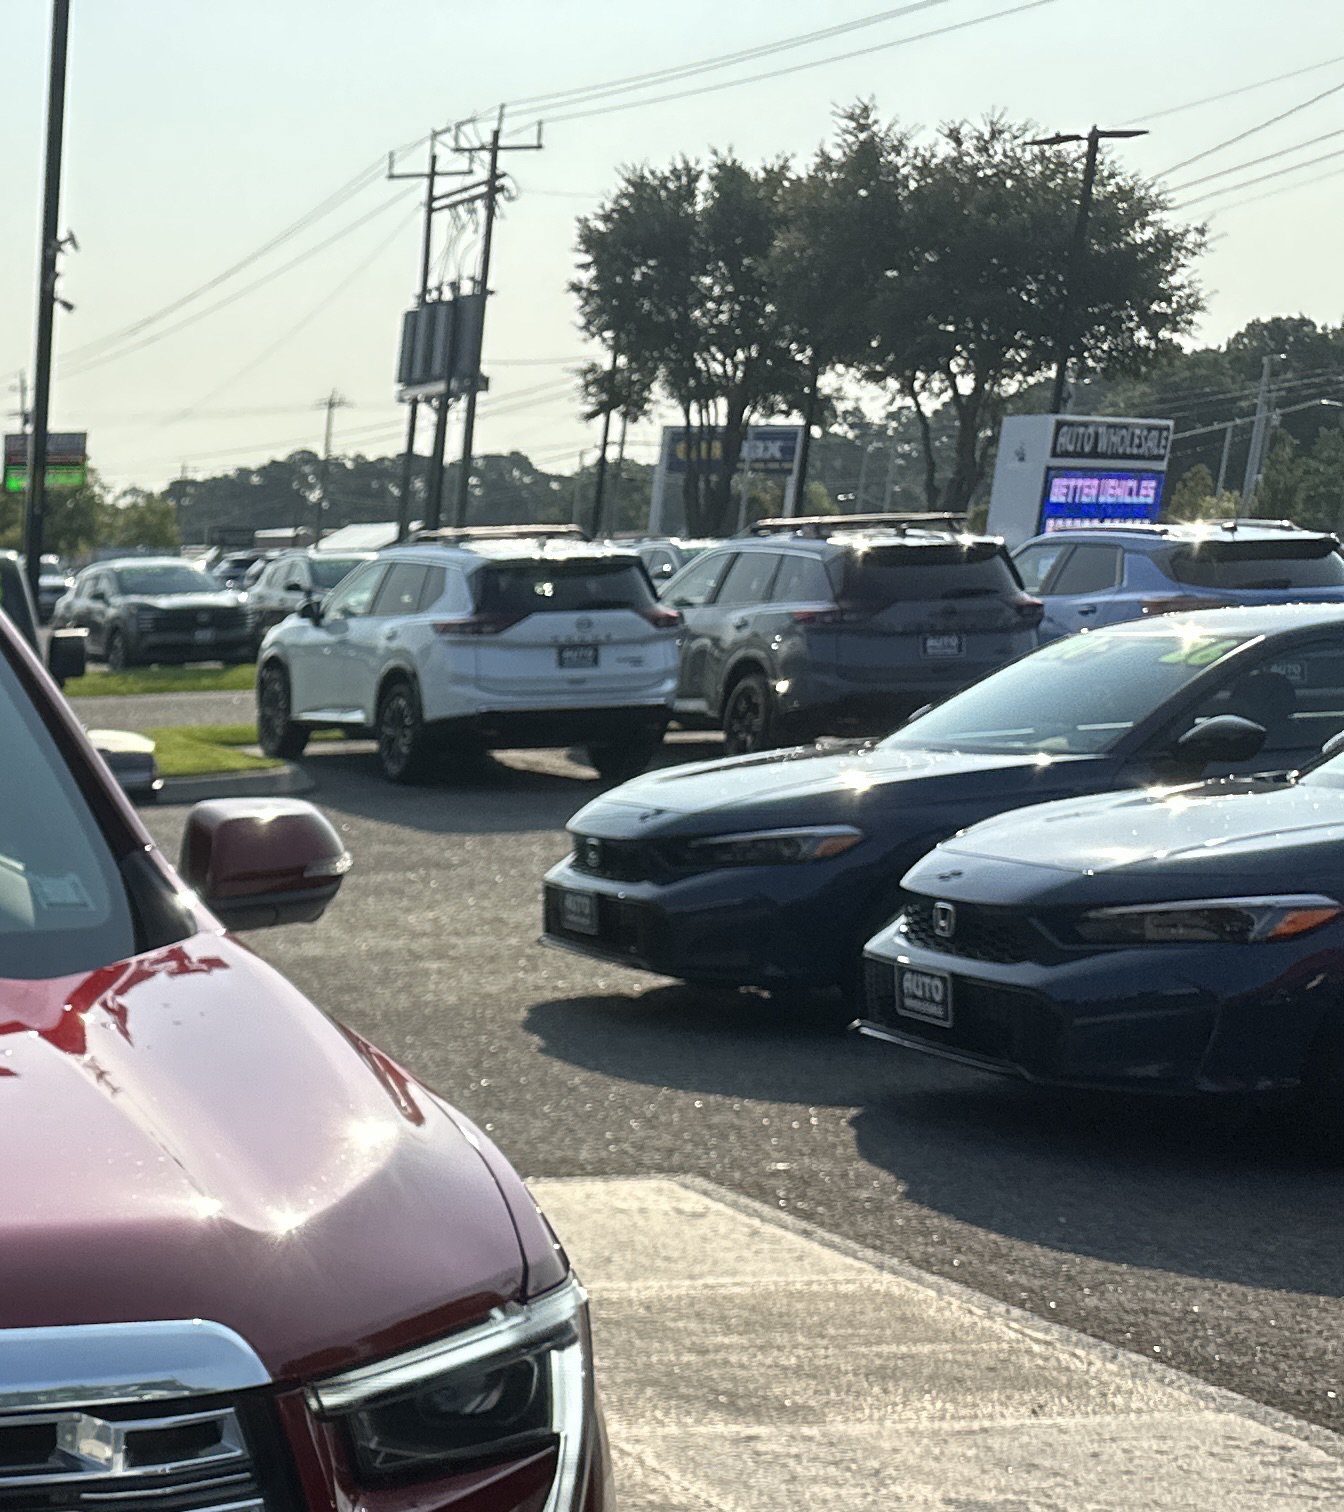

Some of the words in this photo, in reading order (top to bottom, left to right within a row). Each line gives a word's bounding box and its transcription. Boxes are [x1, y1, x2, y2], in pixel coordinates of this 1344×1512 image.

[1055, 424, 1095, 453] AUTO
[1097, 426, 1169, 457] WHOLESALE
[1049, 477, 1098, 504] BETTER
[903, 970, 944, 1003] AUTO
